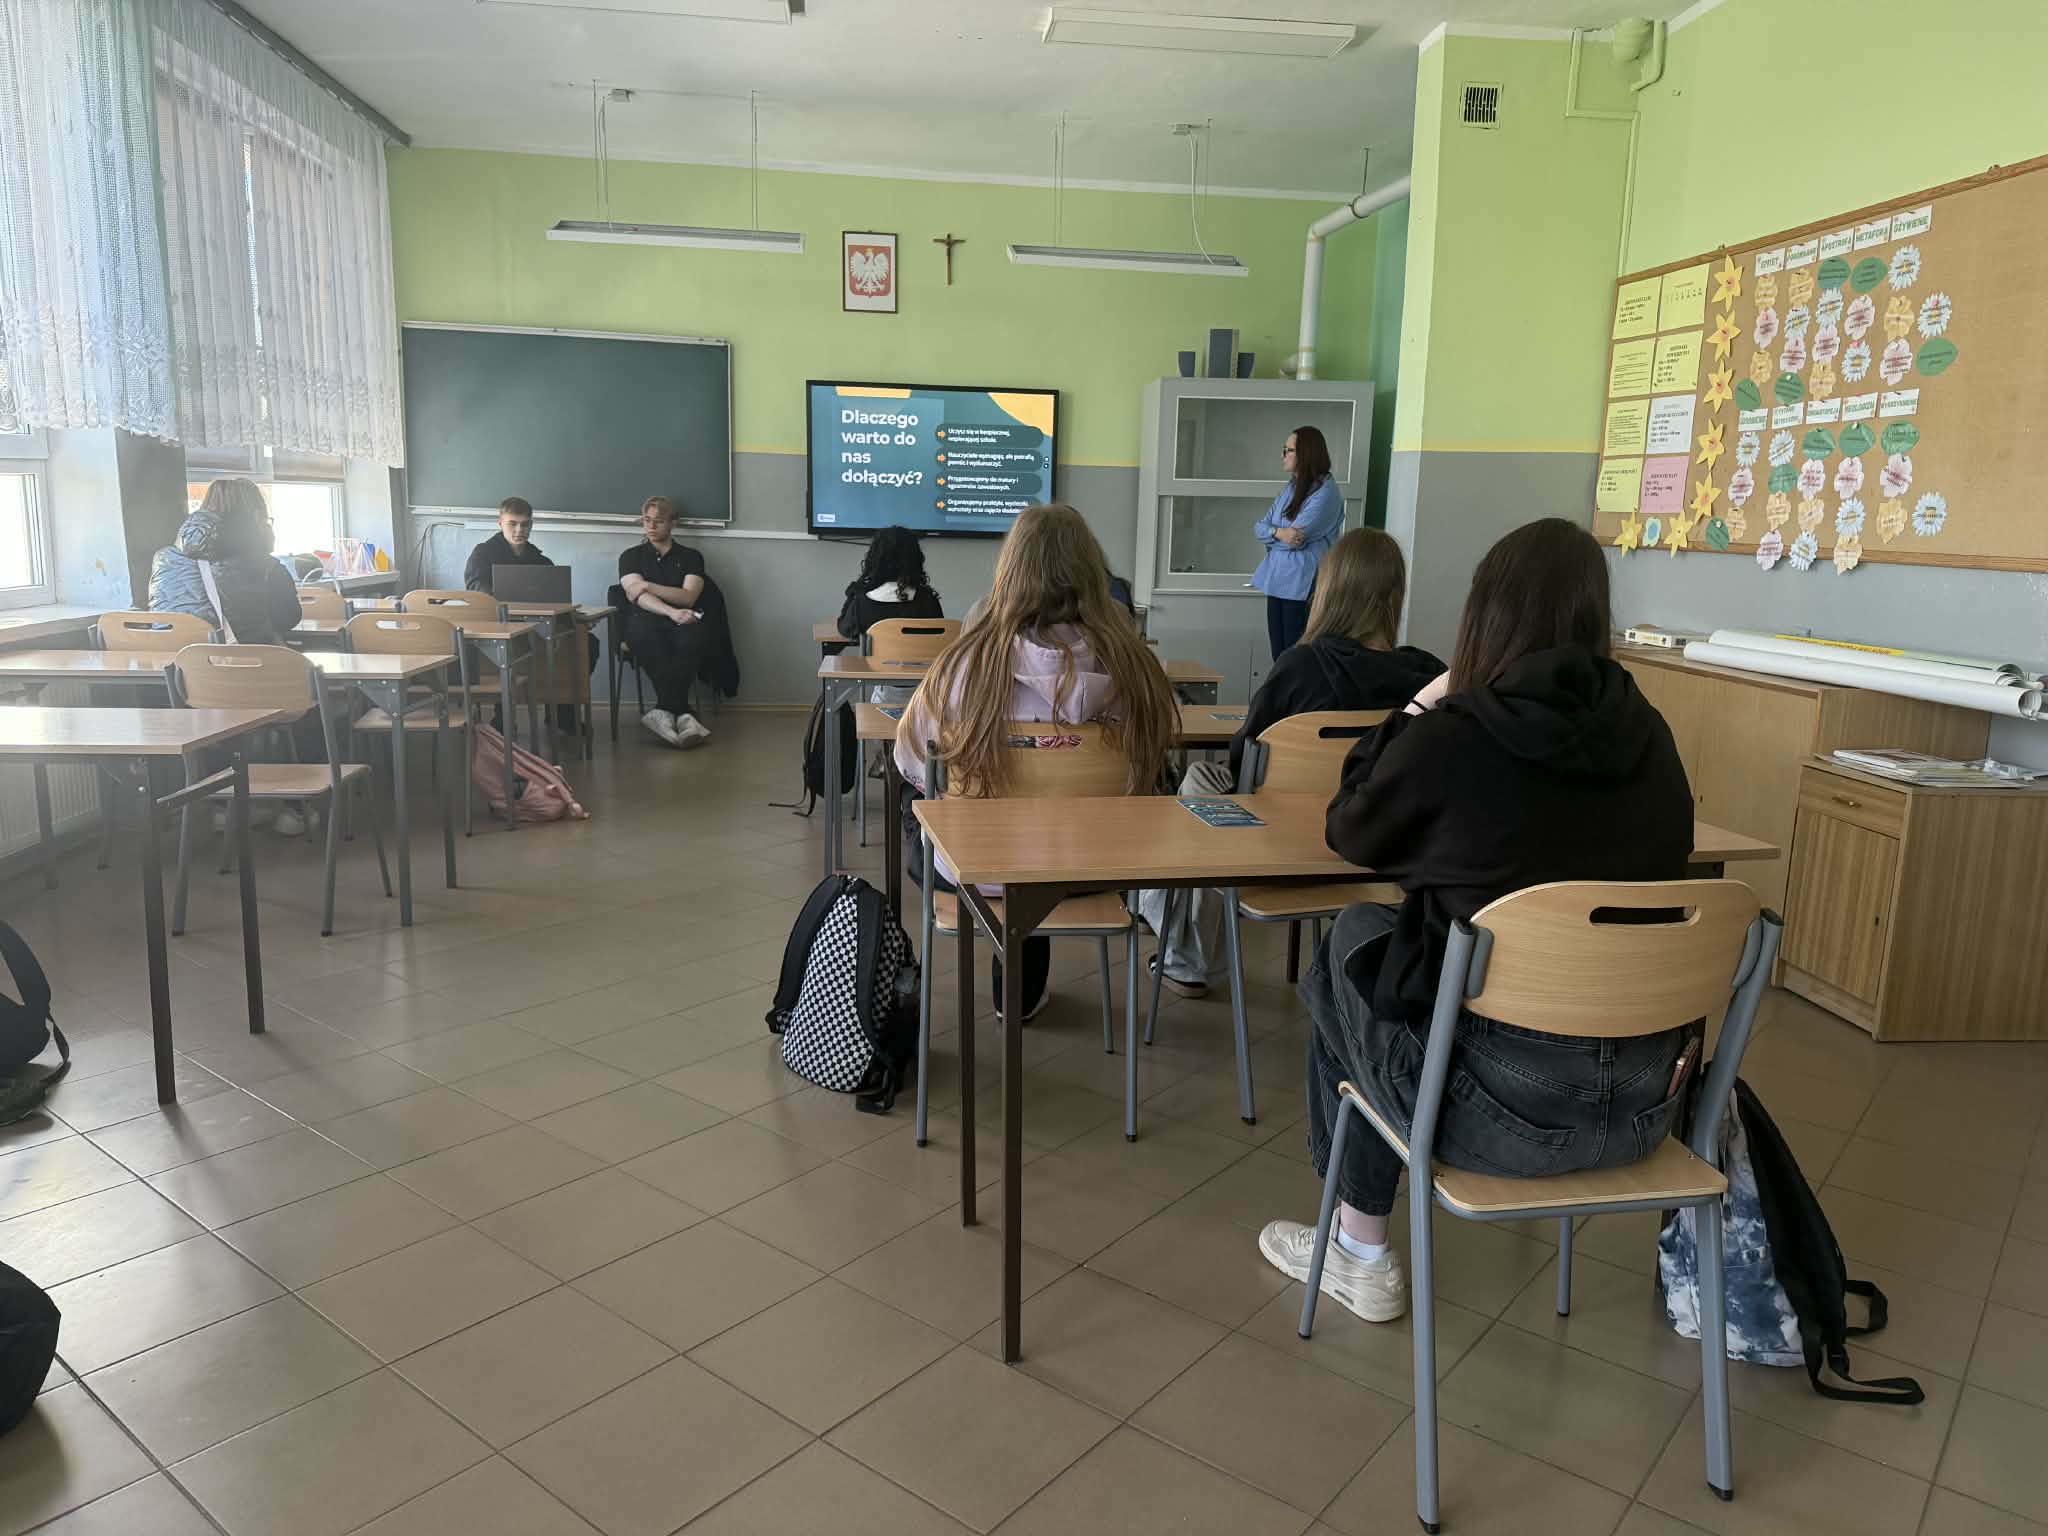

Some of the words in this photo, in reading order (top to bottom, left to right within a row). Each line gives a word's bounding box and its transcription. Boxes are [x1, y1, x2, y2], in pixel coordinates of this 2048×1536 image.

[841, 409, 919, 429] Dlaczego
[841, 432, 891, 445] warto
[894, 431, 916, 446] do
[841, 452, 872, 464] nas
[841, 469, 923, 488] dołączyć?
